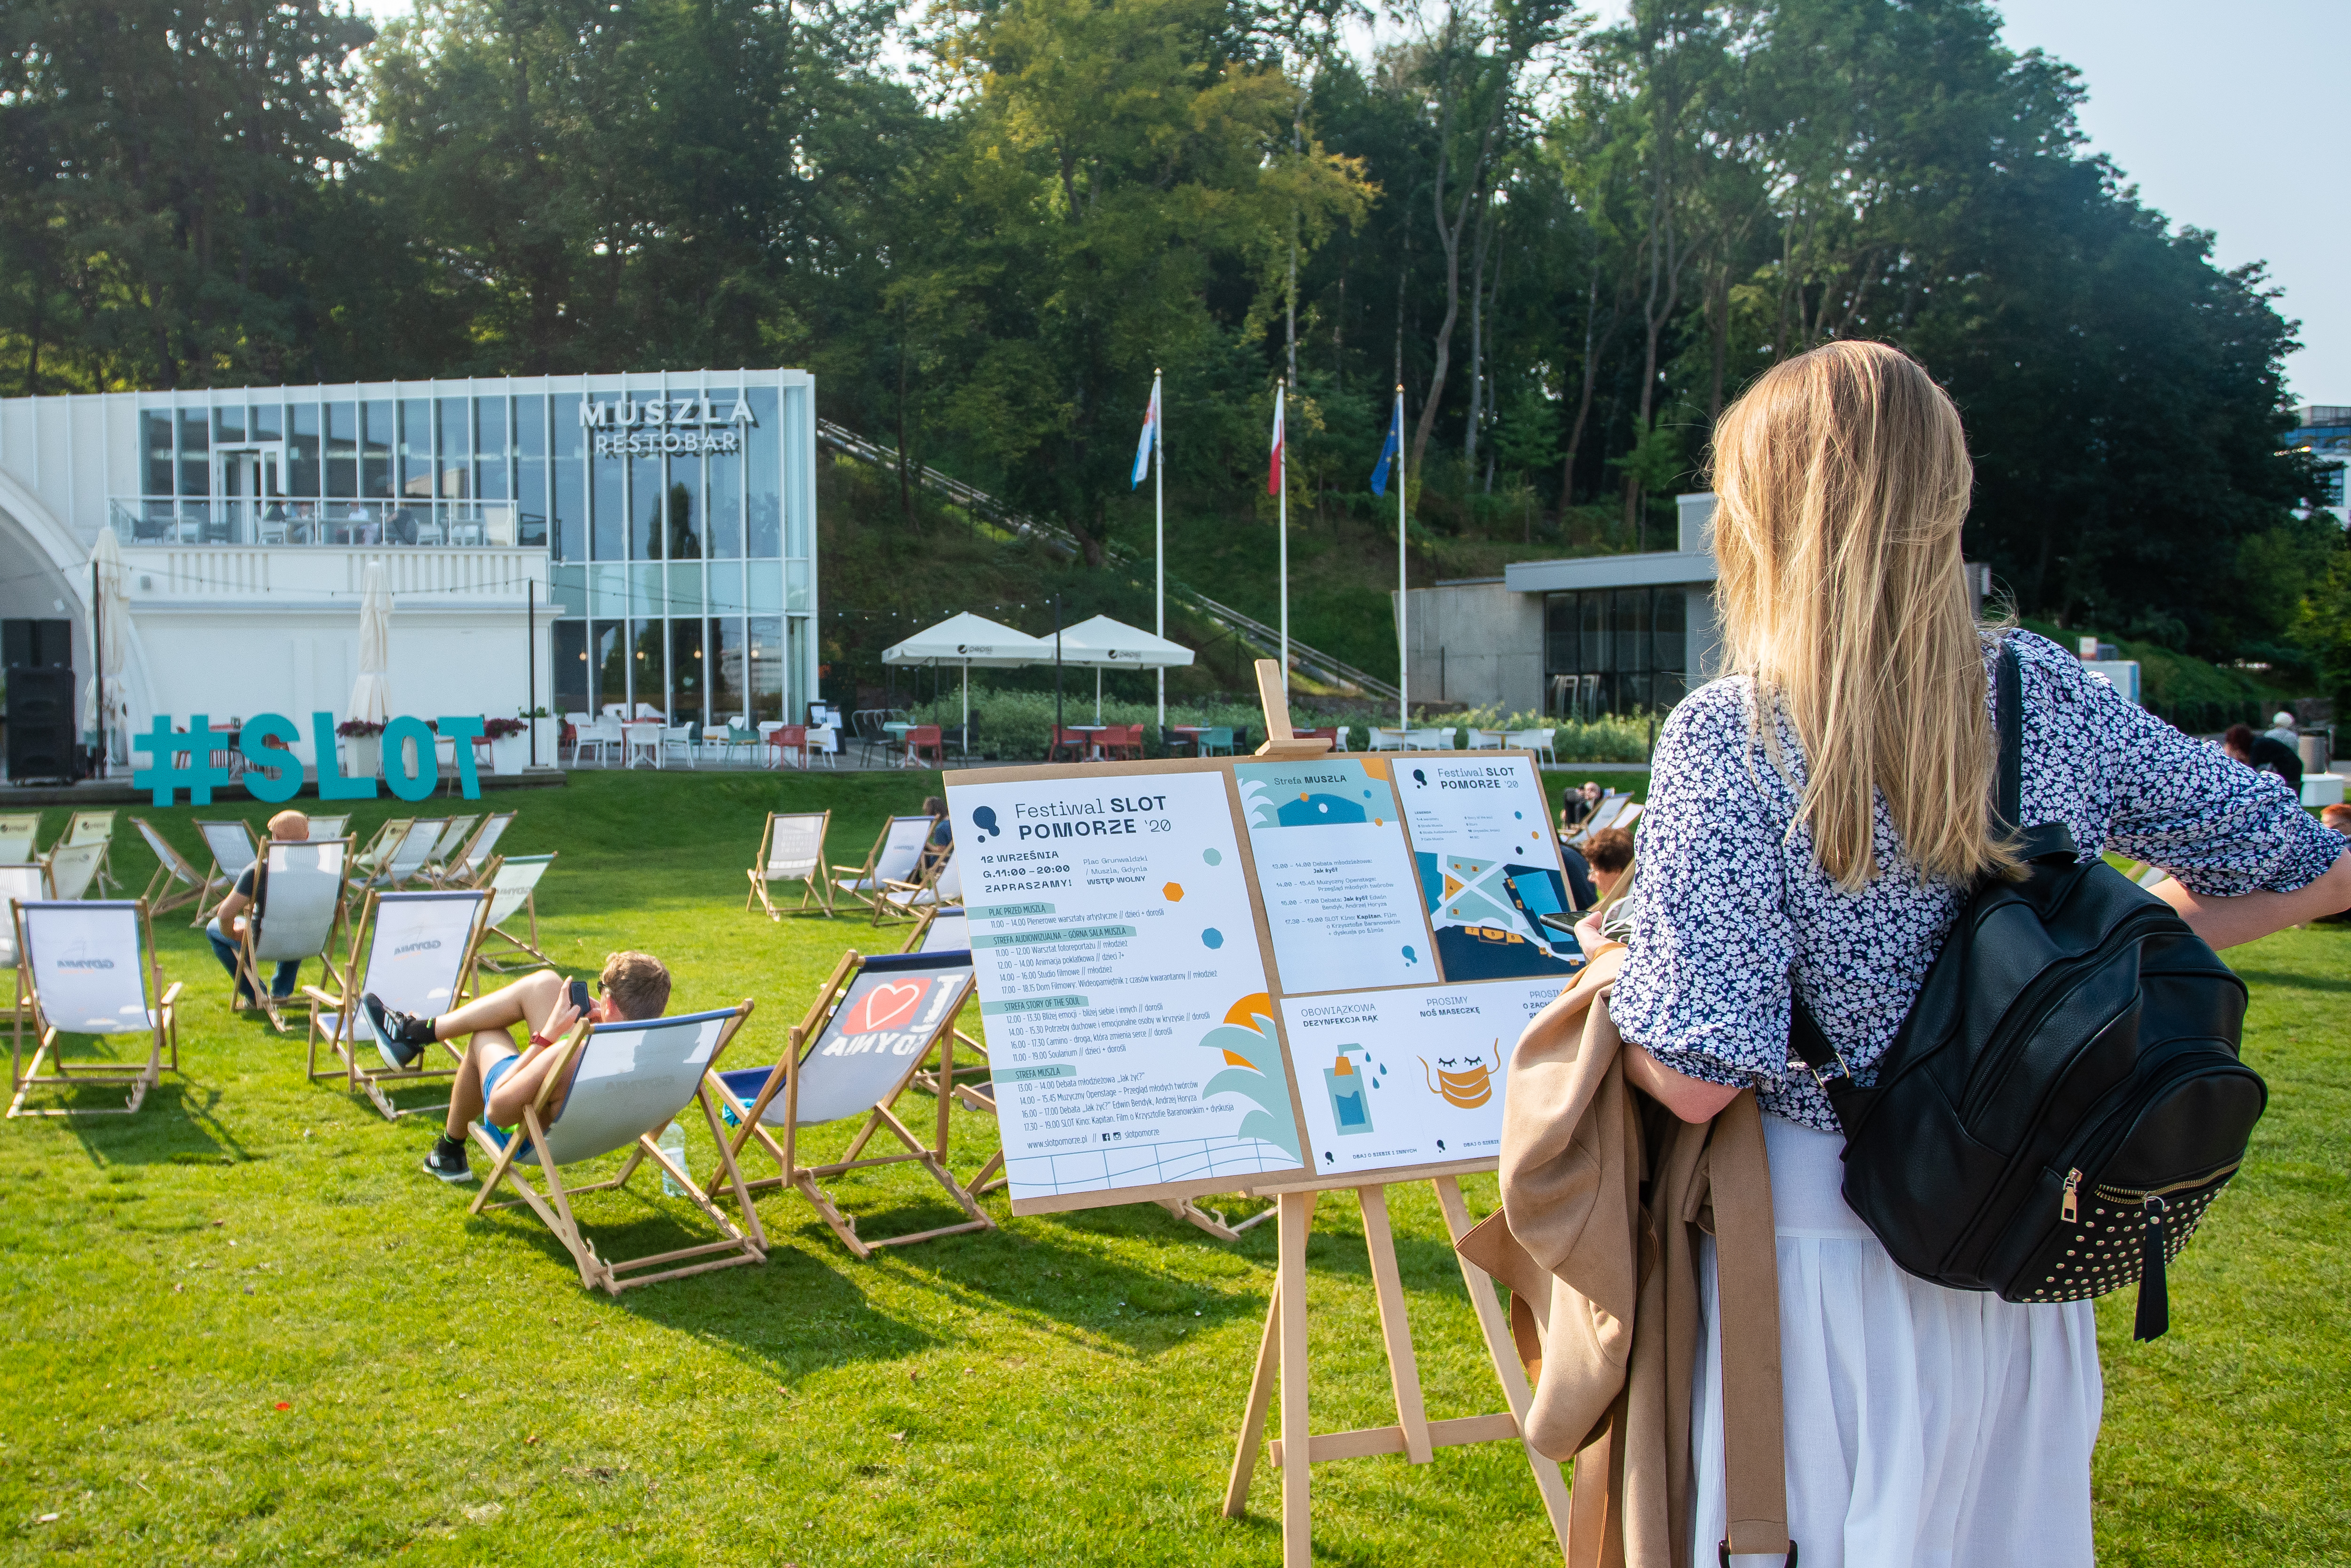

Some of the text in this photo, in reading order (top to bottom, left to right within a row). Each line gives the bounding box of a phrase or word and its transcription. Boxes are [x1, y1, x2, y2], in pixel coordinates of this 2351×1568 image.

[579, 398, 755, 426] MUSZLA
[595, 432, 737, 454] RESTOBAR
[133, 711, 484, 807] #SLOT
[1274, 774, 1347, 785] Strefa MUSZLA
[1437, 767, 1515, 777] Festiwal SLOT
[1440, 780, 1501, 789] POMORZE
[1015, 796, 1166, 819] Festiwal SLOT
[1018, 819, 1136, 840] POMORZE
[980, 850, 1059, 864] 12 WRZEŚNIA
[1101, 855, 1148, 864] Grunwaldzki
[983, 864, 1070, 878] G.11:00 20:00
[1120, 865, 1148, 874] Gdynia
[985, 879, 1072, 893] ZAPRASZAMY!
[988, 907, 1003, 916] PLAC
[1003, 906, 1022, 915] PRZED
[990, 907, 1165, 929] 11.00 14.00 Plenerowe warsztaty artystyczne dzieci dorośli
[993, 927, 1127, 945] STREFA AUDIOWIZUALNA GÓRNA SALA MUSZLA
[995, 939, 1128, 957] 11.00 12.00 Warsztat fotoreportażu młodzież
[997, 951, 1125, 969] 12.00 14.00 Animacja poklatkowa dzieci 7+
[999, 965, 1113, 982] 14.00 16.00 Studio filmowe młodzież
[1001, 969, 1218, 994] 17.00 18.15 Dom Filmowy: Wideopamiętnik czasów kwarantanny młodzież
[1004, 997, 1081, 1011] STREFA STORY OF THE SOUL
[1426, 996, 1467, 1007] PROSIMY
[1006, 1002, 1163, 1024] 12.00 13.30 Bliżej emocji bliżej siebie innych dorośli
[1301, 1003, 1376, 1017] OBOWIĄZKOWA
[1420, 1006, 1480, 1017] NOŚ MASECZKĘ
[1008, 1011, 1210, 1037] 14.00 15.30 Potrzeby duchowe emocjonalne osoby kryzysie dorośli
[1302, 1016, 1361, 1027] DEZYNFEKCJA
[1010, 1040, 1026, 1049] 16.00
[1031, 1038, 1045, 1047] 17.30
[1046, 1036, 1068, 1046] Camino
[1073, 1035, 1093, 1044] droga,
[1092, 1033, 1108, 1041] która
[1109, 1031, 1131, 1040] zmienia
[1153, 1026, 1173, 1036] dorośli
[1012, 1044, 1127, 1062] 11.00 19.00 Soularium dzieci dorośli
[1015, 1067, 1061, 1079] STREFA MUSZLA
[1017, 1082, 1033, 1092] 13.00
[1039, 1080, 1055, 1090] 14.00
[1055, 1079, 1077, 1088] Debata
[1077, 1076, 1116, 1086] młodzieżowa
[1019, 1080, 1198, 1105] 14.00 15.45 Muzyczny Openstage Przegląd młodych twórców
[1021, 1109, 1037, 1119] 16.00
[1044, 1106, 1058, 1116] 17.00
[1059, 1105, 1081, 1114] Debata
[1112, 1100, 1130, 1109] Edwin
[1130, 1097, 1154, 1107] Bendyk,
[1155, 1095, 1176, 1105] Andrzej
[1176, 1094, 1197, 1103] Horyza
[1023, 1103, 1234, 1132] 17.30 19.00 SLOT Kino: Kapitan. Film Krzysztofie Baranowskim dyskusja
[1026, 1134, 1088, 1149] www.slotpomorze.pl
[1124, 1128, 1160, 1139] slotpomorze
